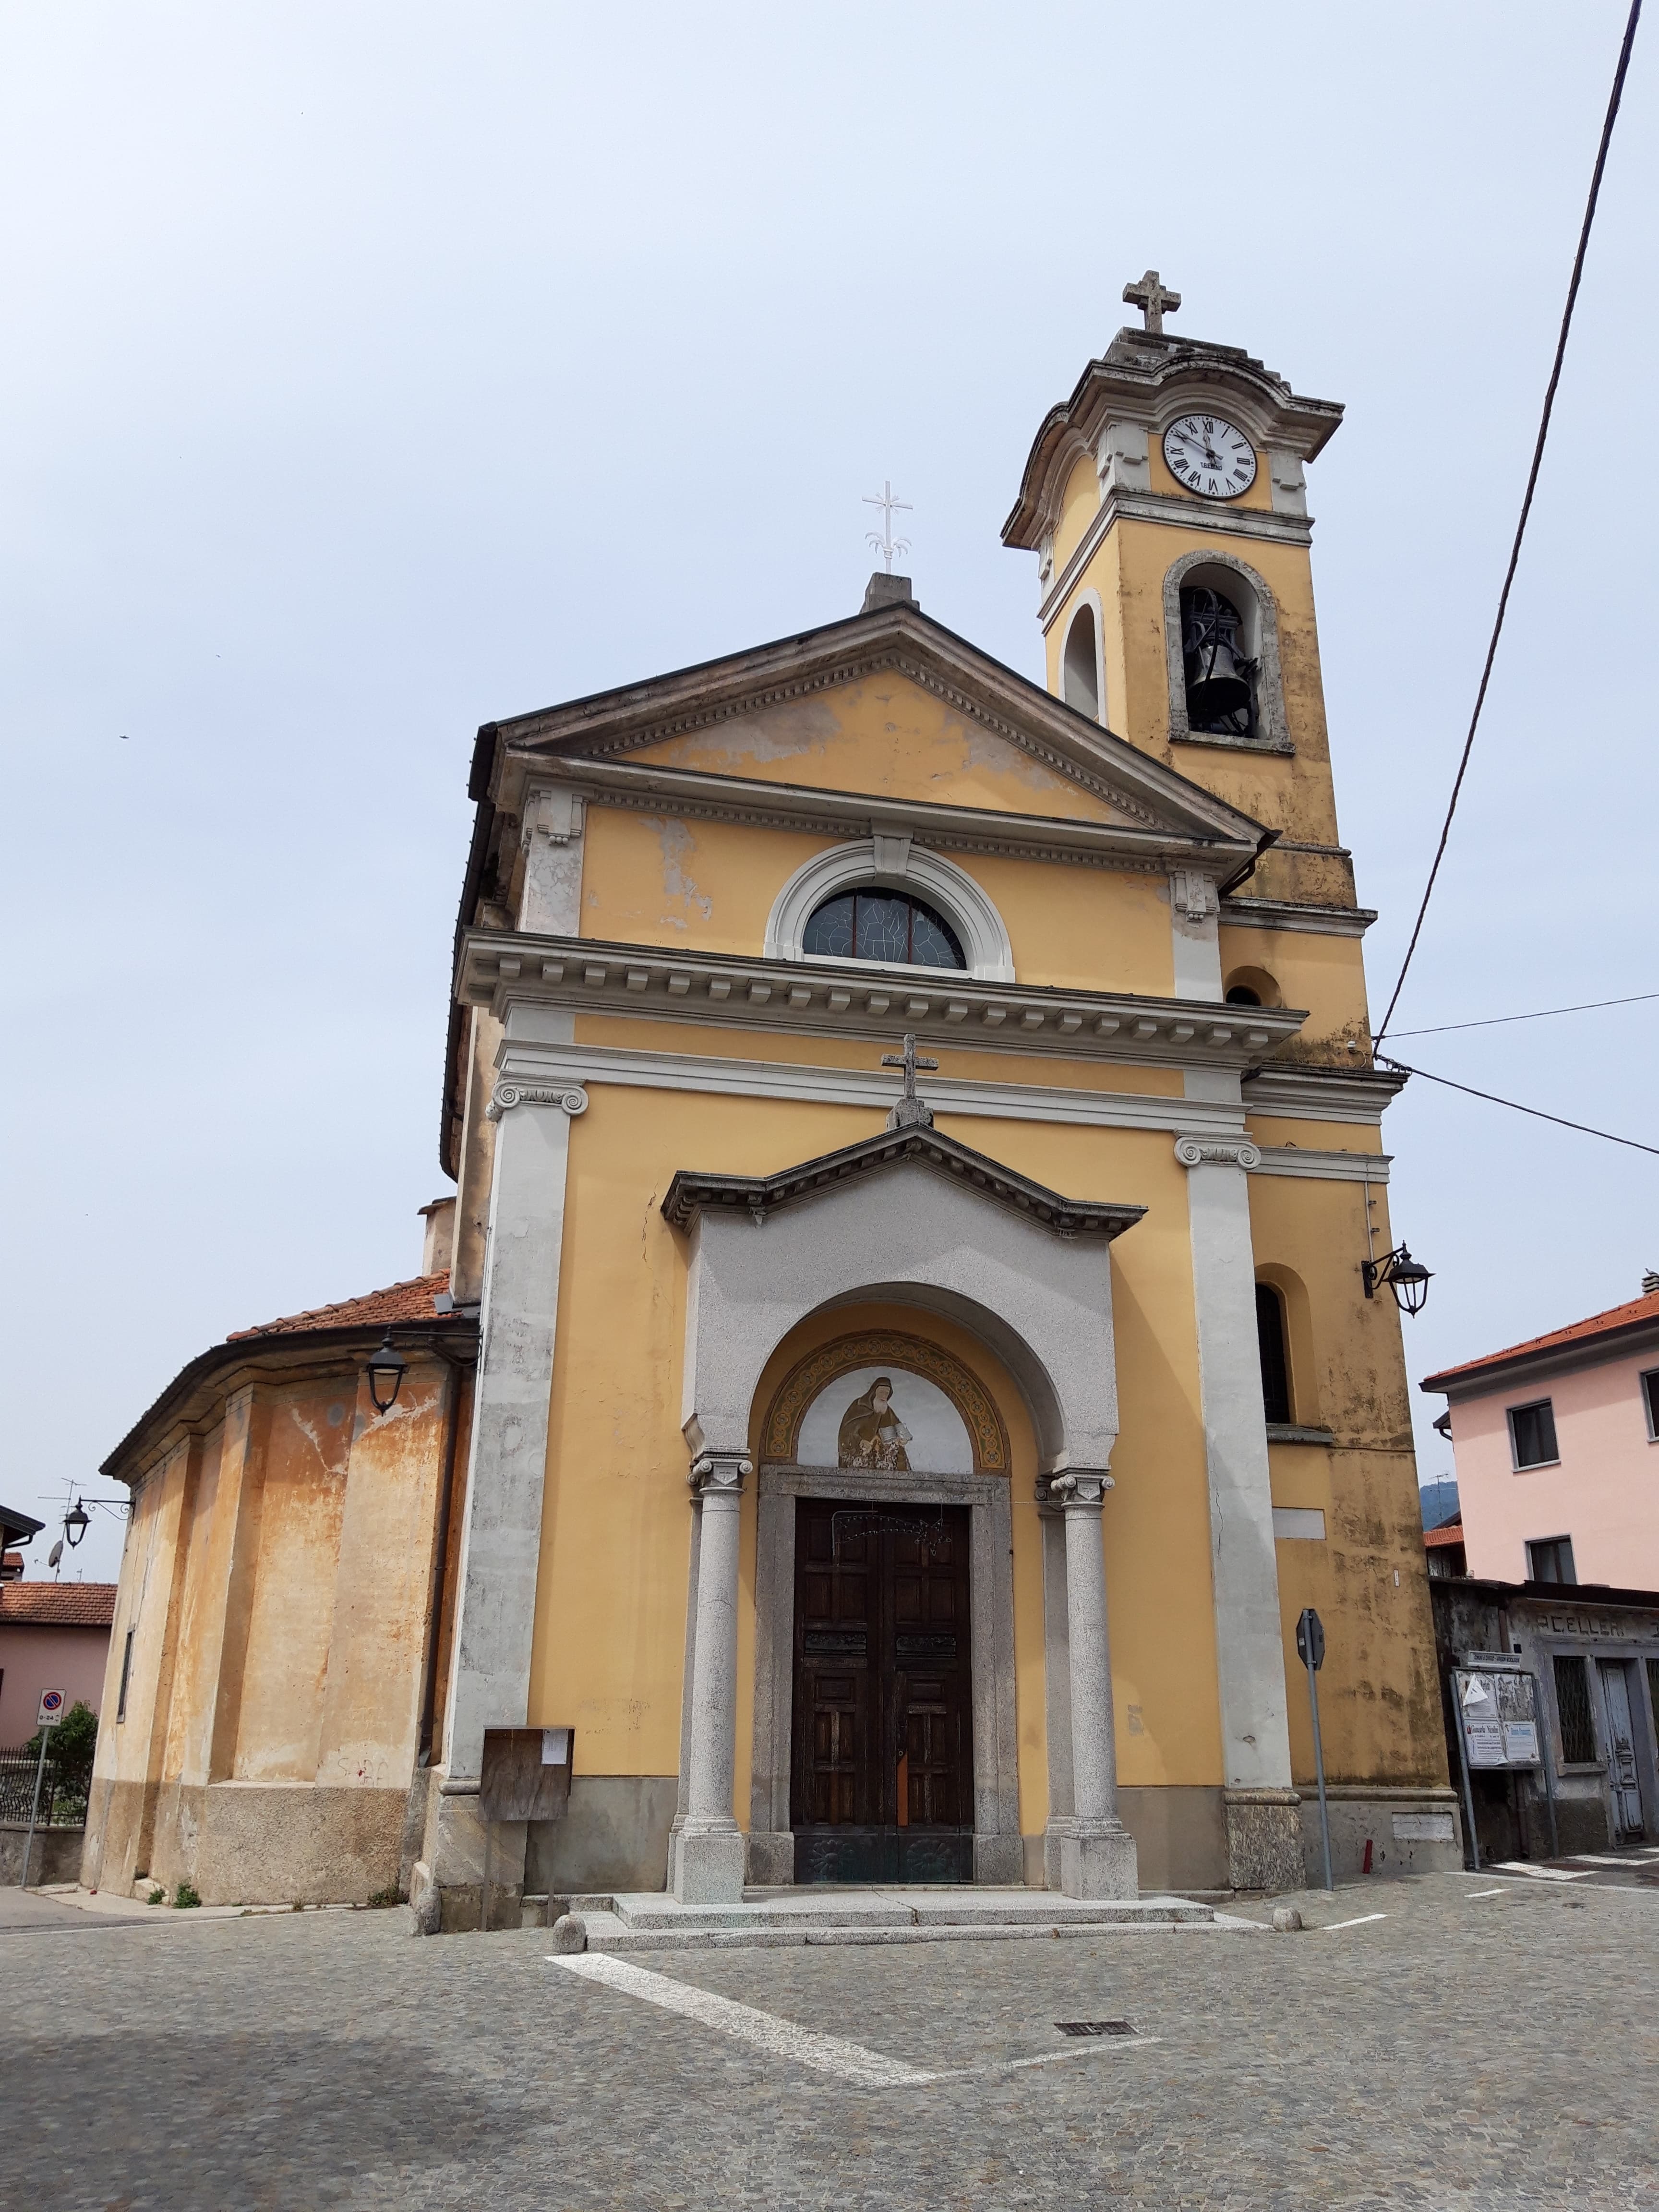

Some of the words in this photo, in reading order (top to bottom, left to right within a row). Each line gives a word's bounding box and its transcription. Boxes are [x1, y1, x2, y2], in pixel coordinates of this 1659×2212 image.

[1185, 421, 1198, 435] XI
[1202, 421, 1214, 433] XII
[1170, 446, 1184, 455] IX
[1174, 458, 1190, 473] VIII
[1200, 462, 1222, 470] TREBINO
[1188, 471, 1201, 486] VII
[1209, 478, 1218, 492] VI
[1226, 477, 1236, 491] V
